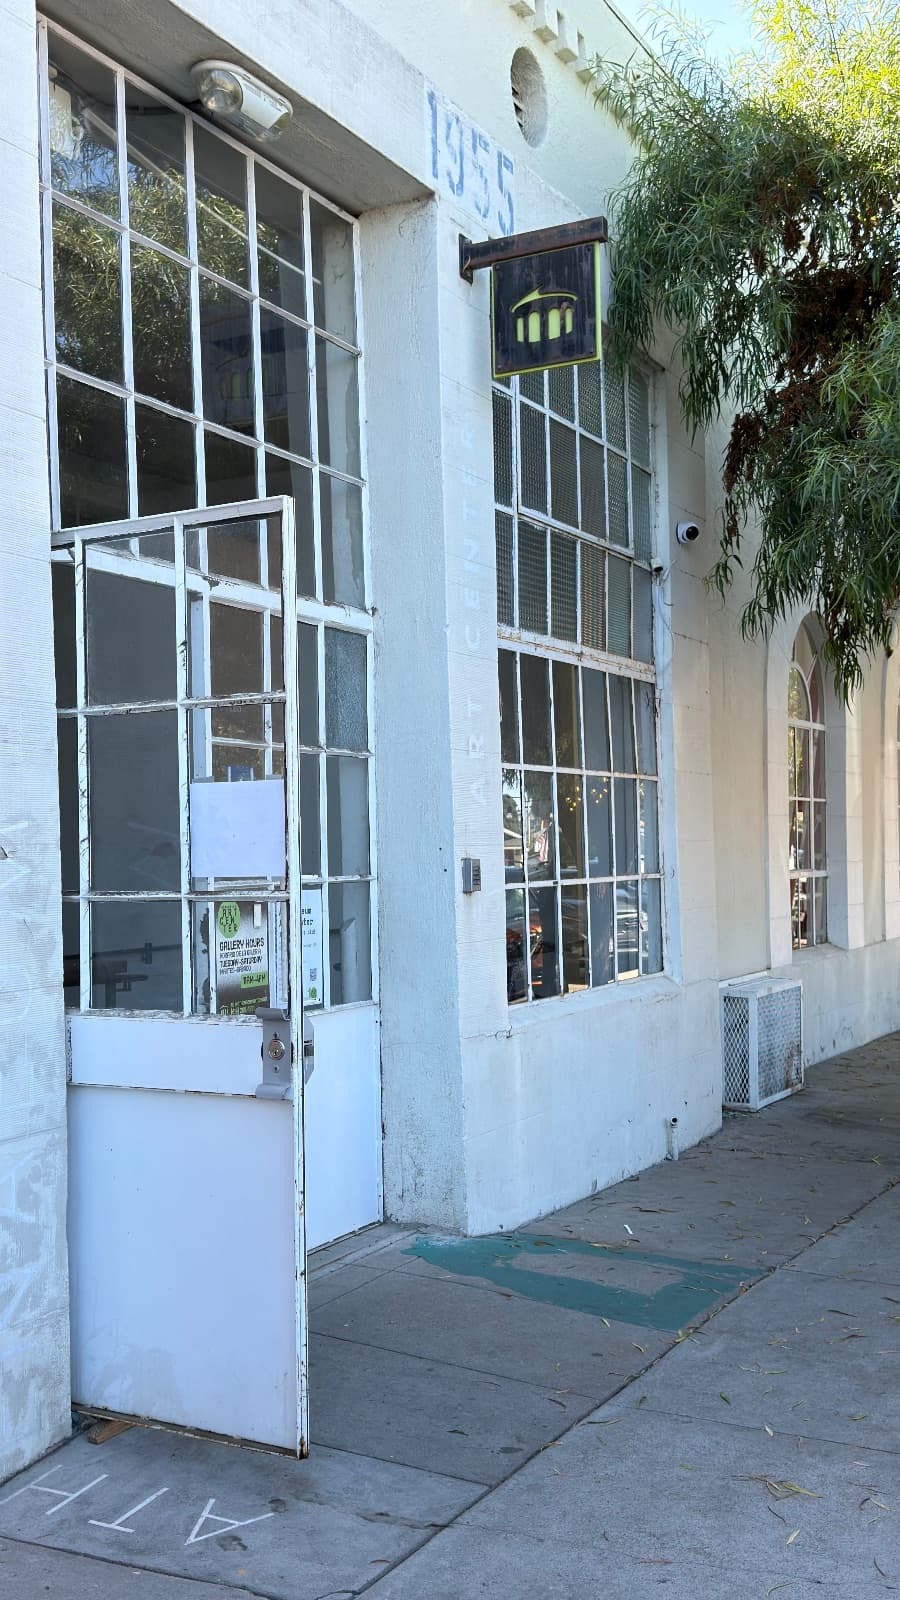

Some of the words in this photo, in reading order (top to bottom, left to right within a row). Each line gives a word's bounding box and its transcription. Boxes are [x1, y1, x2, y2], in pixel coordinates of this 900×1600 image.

[427, 89, 516, 237] 1955
[466, 697, 488, 806] ART
[220, 940, 244, 951] GALLERY
[246, 937, 265, 947] HOURS
